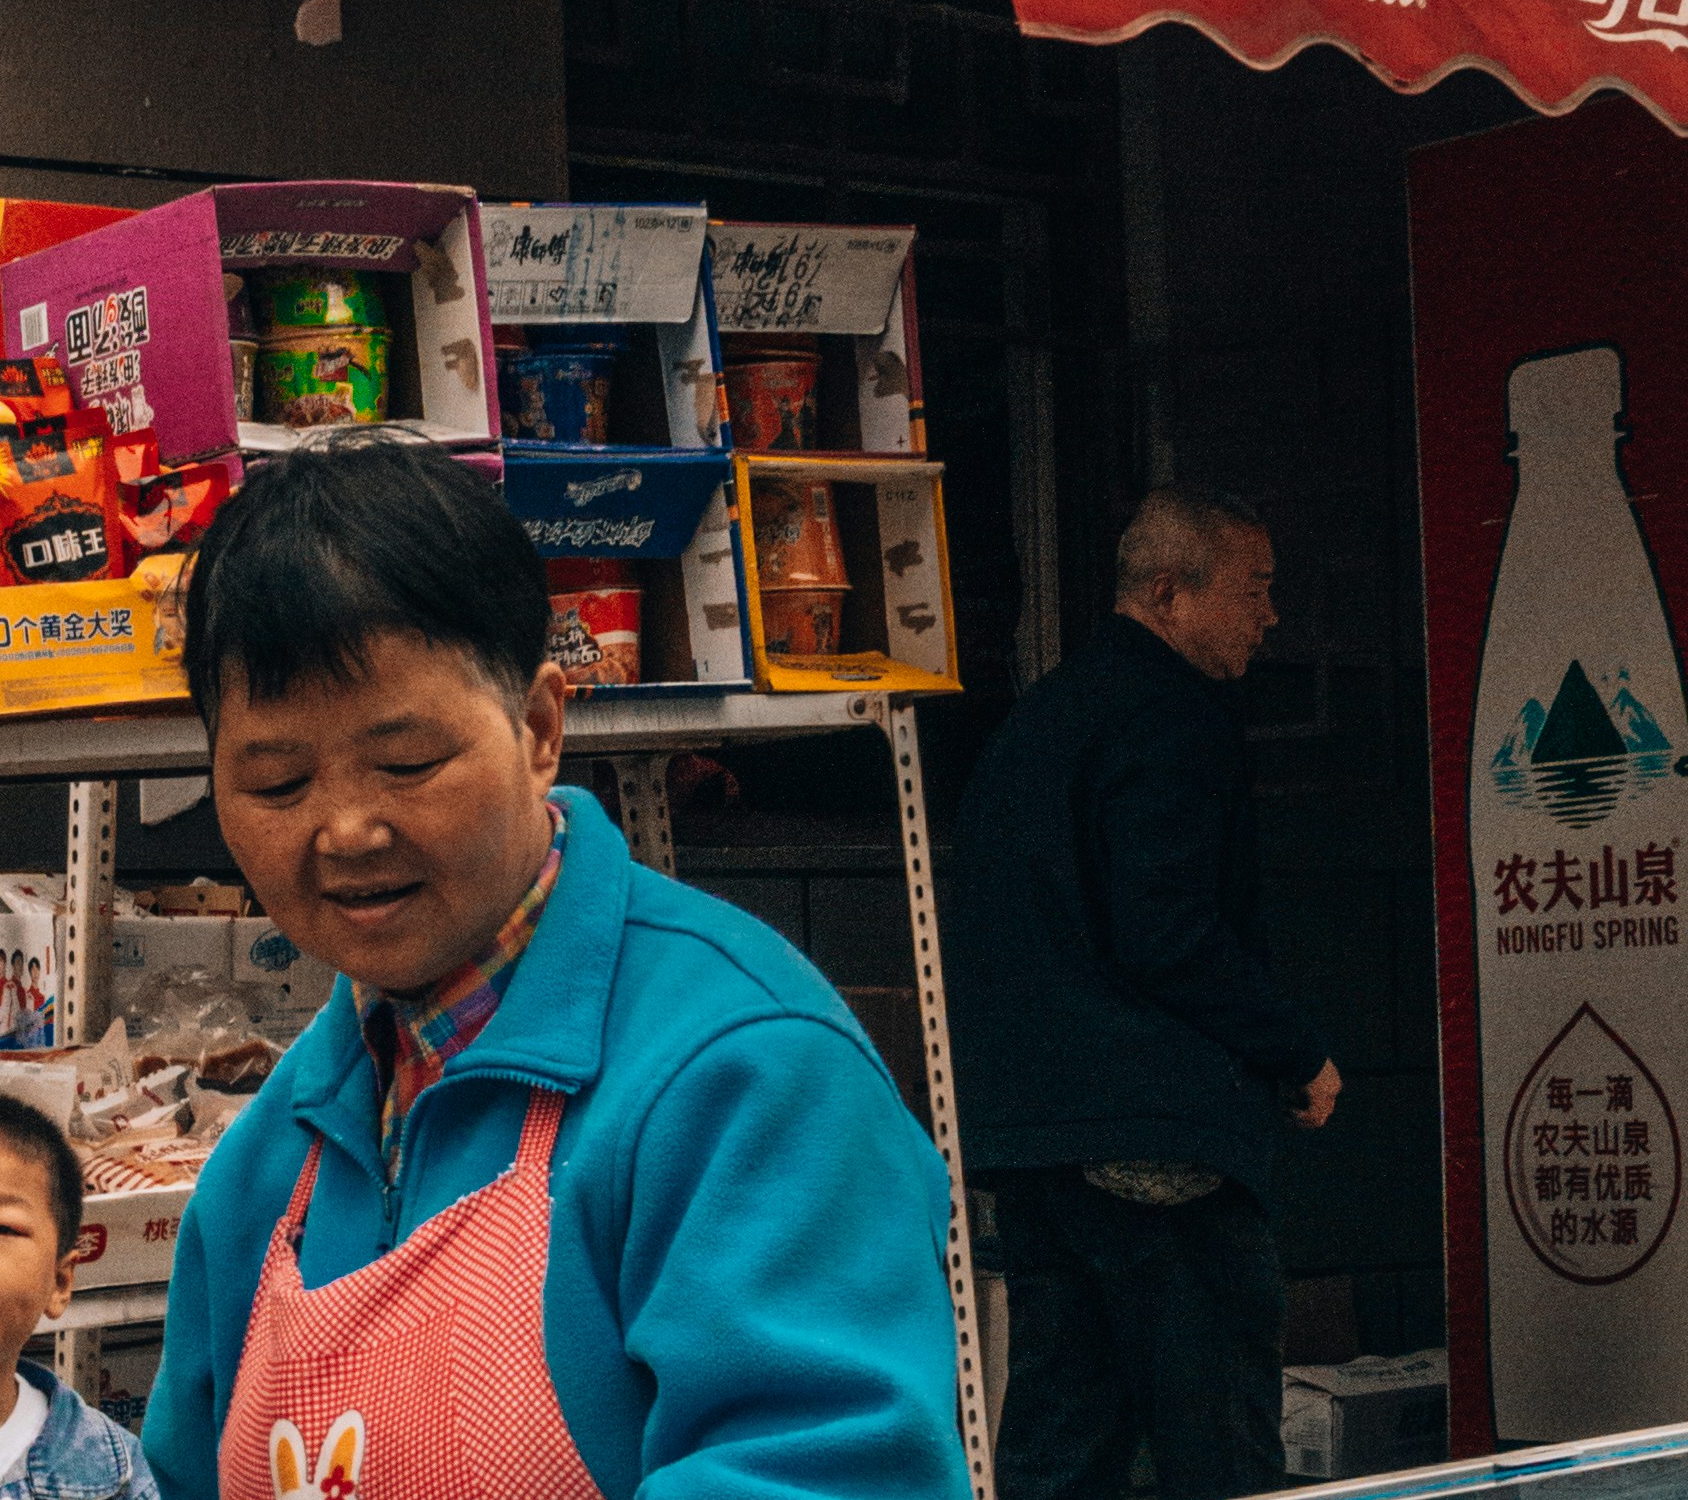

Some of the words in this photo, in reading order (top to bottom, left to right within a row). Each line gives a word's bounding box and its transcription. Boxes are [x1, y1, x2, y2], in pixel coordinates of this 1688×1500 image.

[22, 527, 107, 569] 口味王
[1494, 841, 1679, 916] 农夫山泉
[1497, 921, 1584, 956] NONGFU
[1593, 916, 1679, 950] SPRING
[1546, 1074, 1634, 1113] 每一滴
[1533, 1119, 1650, 1158] 农夫山泉
[1534, 1163, 1653, 1202] 都有优质
[1550, 1207, 1639, 1247] 的水源
